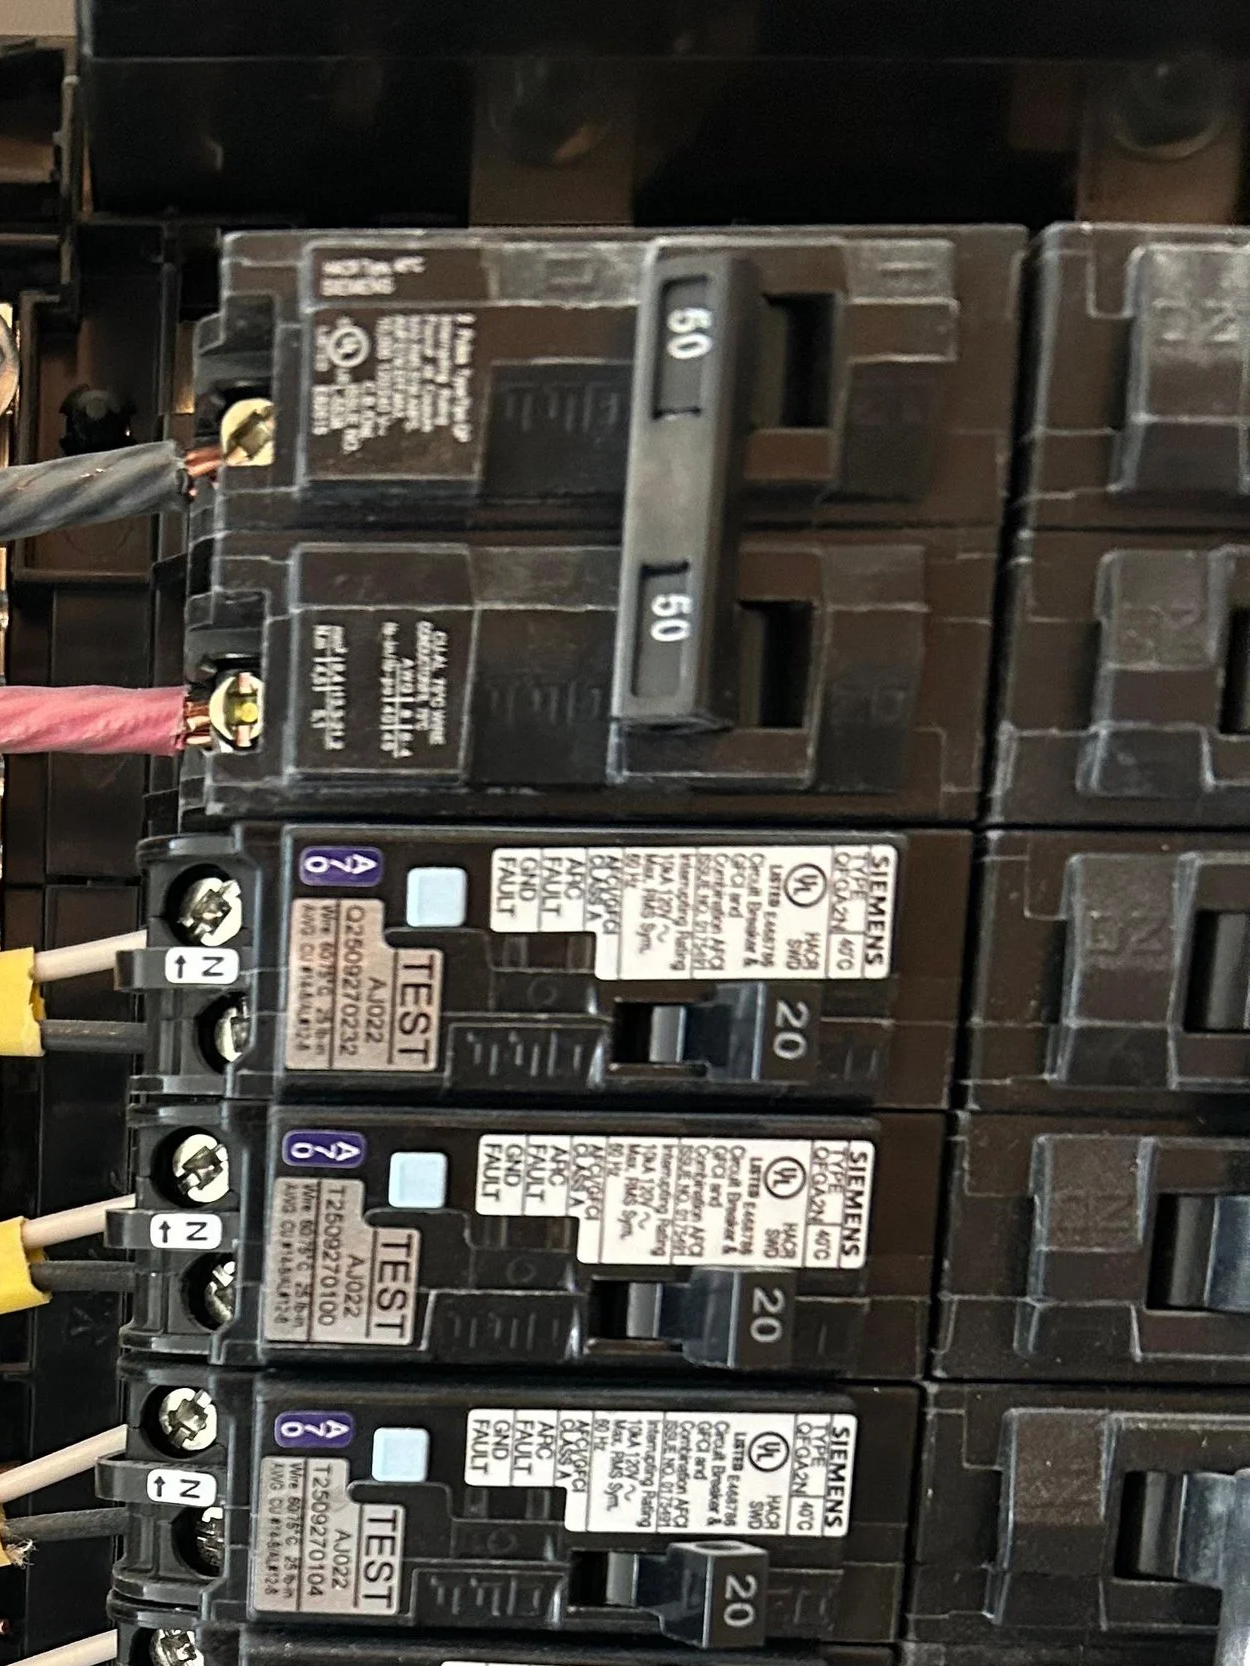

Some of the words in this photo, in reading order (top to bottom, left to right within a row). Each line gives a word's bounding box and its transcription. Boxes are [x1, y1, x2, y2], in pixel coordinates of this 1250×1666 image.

[650, 593, 693, 643] 50
[865, 855, 890, 966] SIEMENS
[202, 956, 224, 976] N
[365, 976, 386, 1043] AJ022
[398, 955, 435, 1064] TEST
[773, 1002, 809, 1060] 20
[187, 1221, 208, 1242] N
[842, 1151, 868, 1258] SIEMENS
[344, 1254, 365, 1318] AJ022
[375, 1234, 412, 1338] TEST
[750, 1288, 784, 1343] 20
[179, 1480, 200, 1498] N
[825, 1427, 850, 1528] SIEMENS
[307, 1464, 332, 1597] T2509270104
[332, 1528, 353, 1589] AJ022
[363, 1510, 397, 1608] TEST
[723, 1575, 757, 1628] 20
